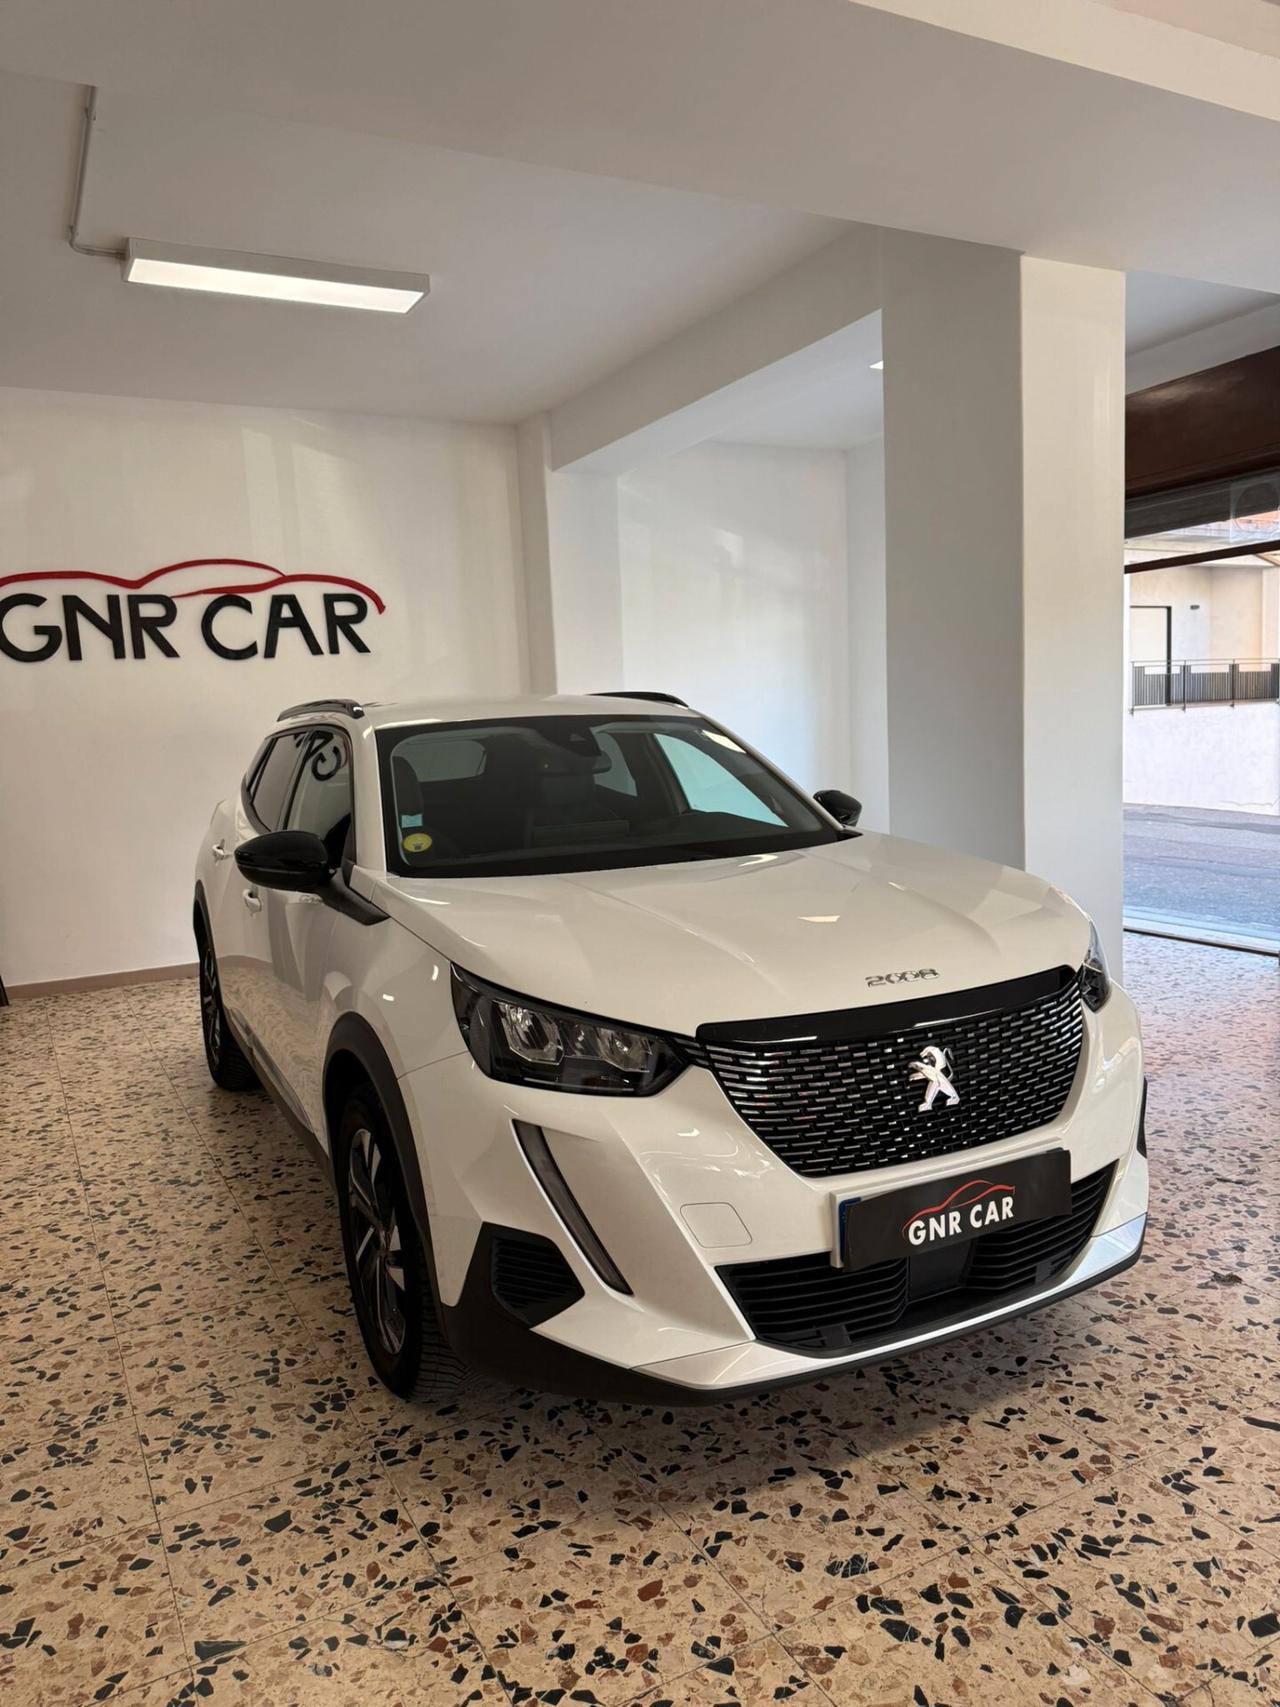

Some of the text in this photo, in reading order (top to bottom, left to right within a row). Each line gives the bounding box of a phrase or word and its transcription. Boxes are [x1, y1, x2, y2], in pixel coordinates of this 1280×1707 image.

[0, 593, 371, 663] GNR CAR
[865, 968, 939, 988] 2008
[908, 1196, 1014, 1246] GNR CAR
